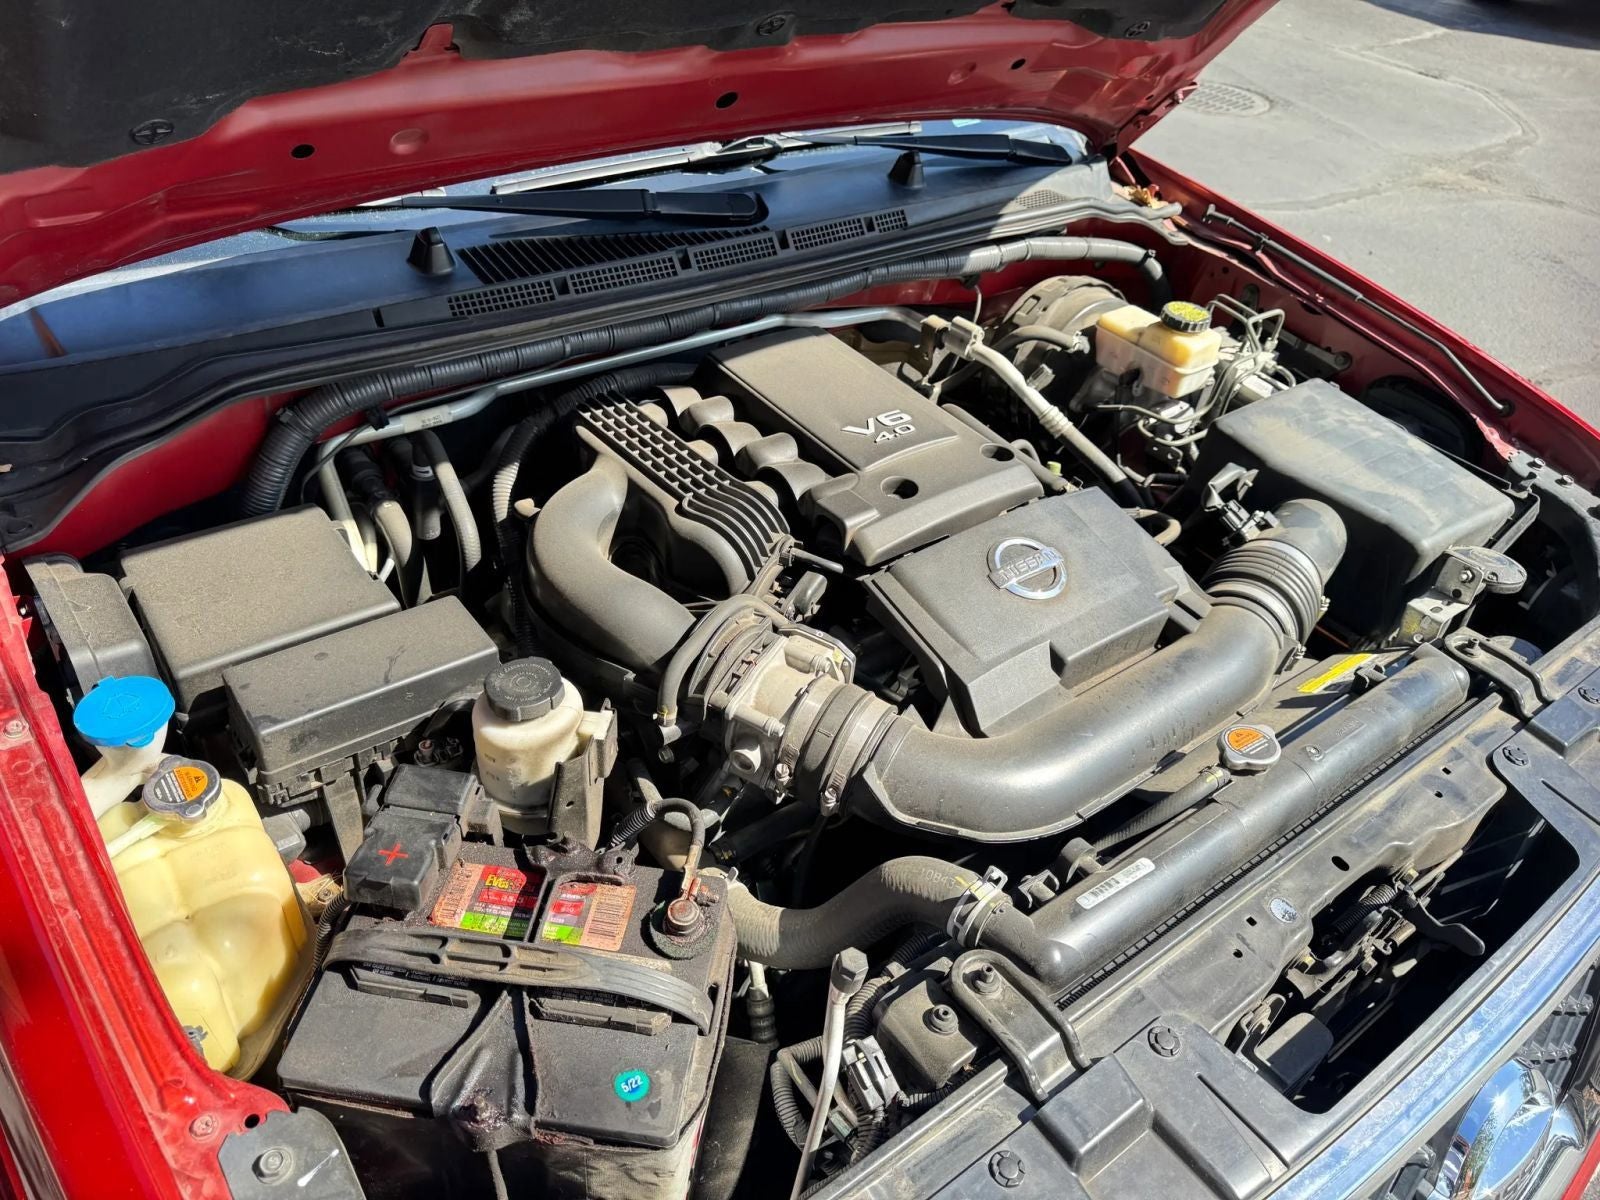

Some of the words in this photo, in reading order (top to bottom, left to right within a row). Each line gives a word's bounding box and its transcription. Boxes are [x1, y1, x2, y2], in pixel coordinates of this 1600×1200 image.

[841, 409, 912, 435] V6
[874, 424, 915, 443] 4.0
[999, 549, 1058, 581] NISSAN
